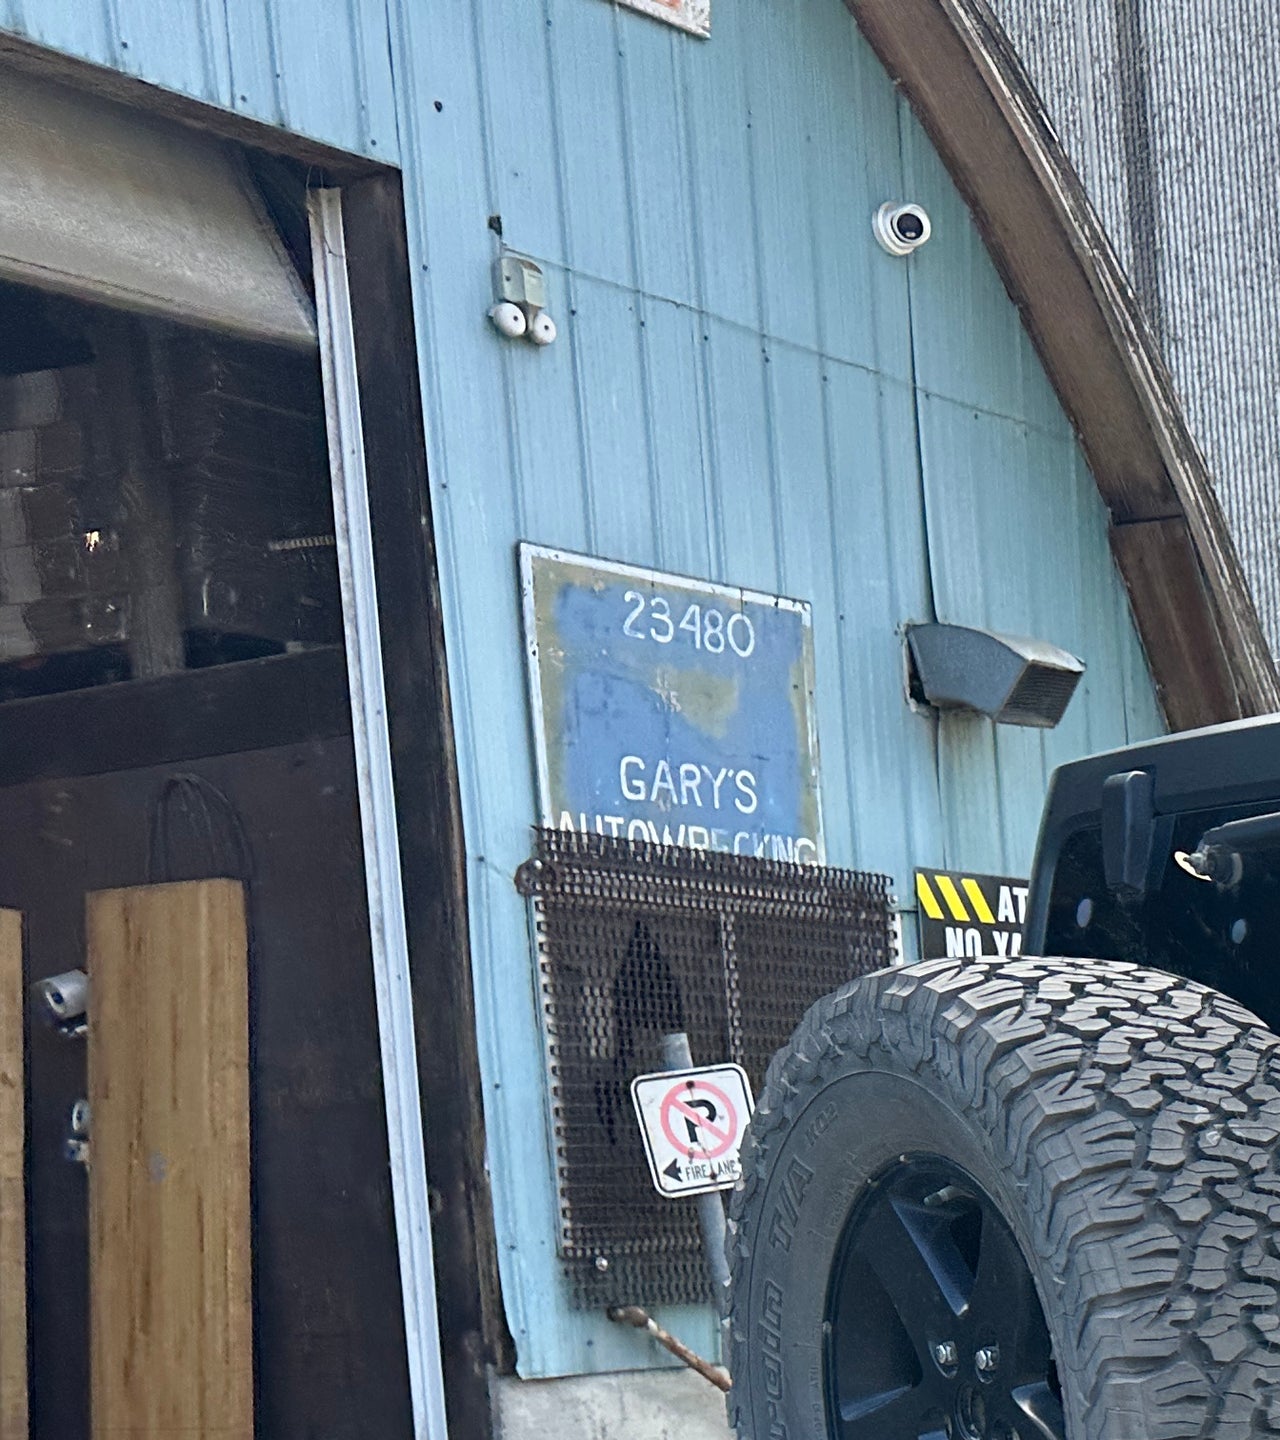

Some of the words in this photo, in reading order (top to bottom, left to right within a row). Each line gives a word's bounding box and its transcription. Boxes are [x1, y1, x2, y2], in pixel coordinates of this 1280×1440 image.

[622, 590, 756, 658] 23480
[619, 756, 759, 815] GARY'S
[685, 1162, 707, 1181] FIRE
